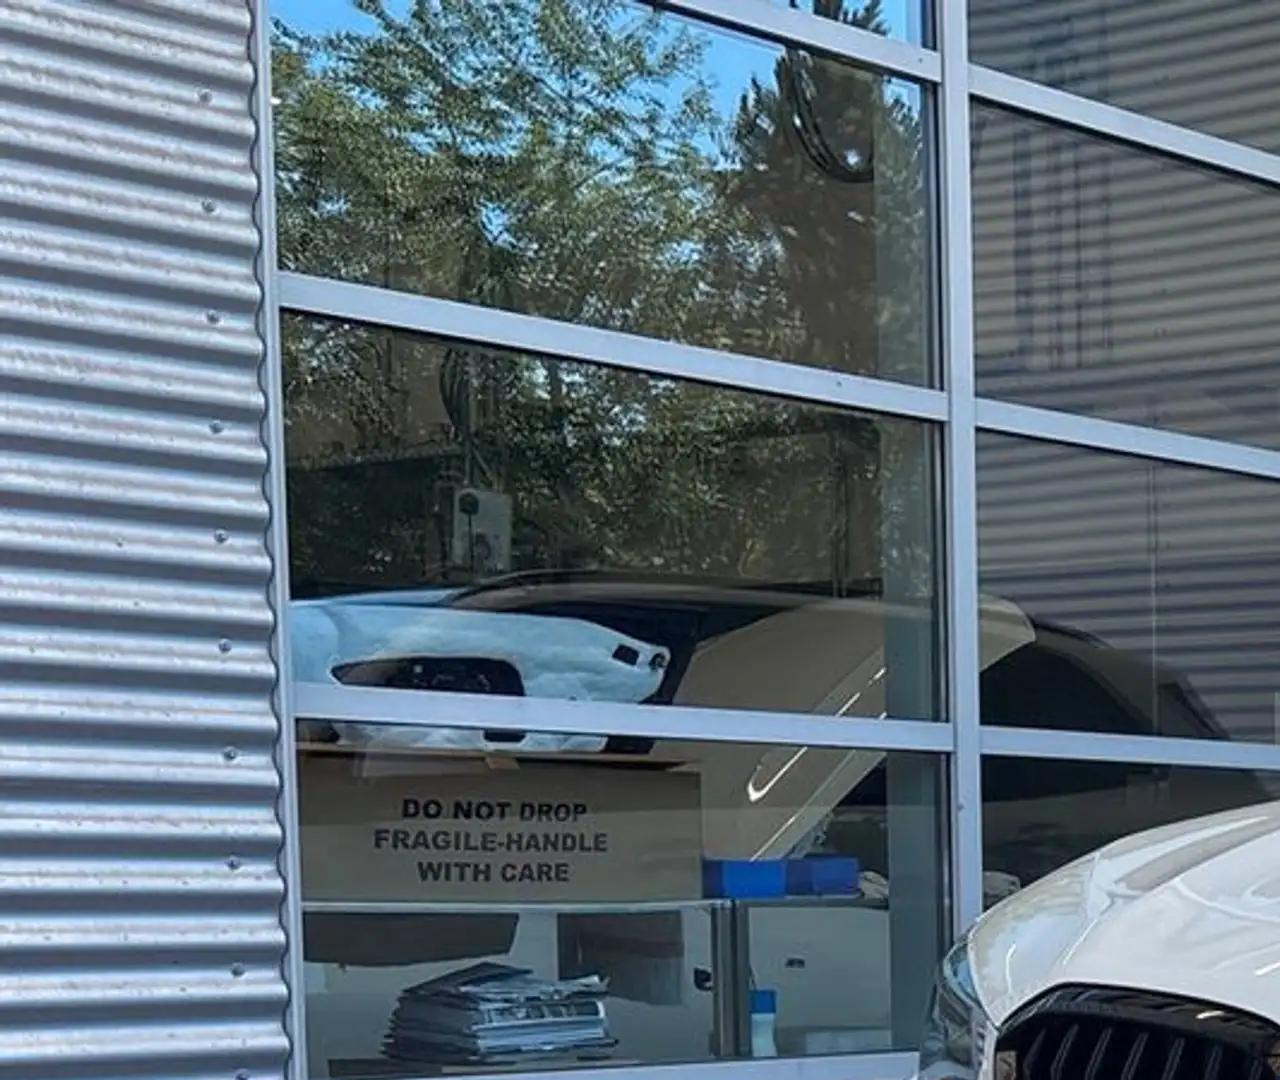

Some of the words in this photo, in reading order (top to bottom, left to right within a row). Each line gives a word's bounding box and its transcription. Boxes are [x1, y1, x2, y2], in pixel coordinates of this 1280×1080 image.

[401, 798, 442, 821] DO
[452, 800, 510, 821] NOT
[519, 802, 588, 822] DROP
[373, 829, 608, 853] FRAGILE-HANDLE
[417, 861, 492, 882] WITH
[500, 862, 570, 883] CARE
